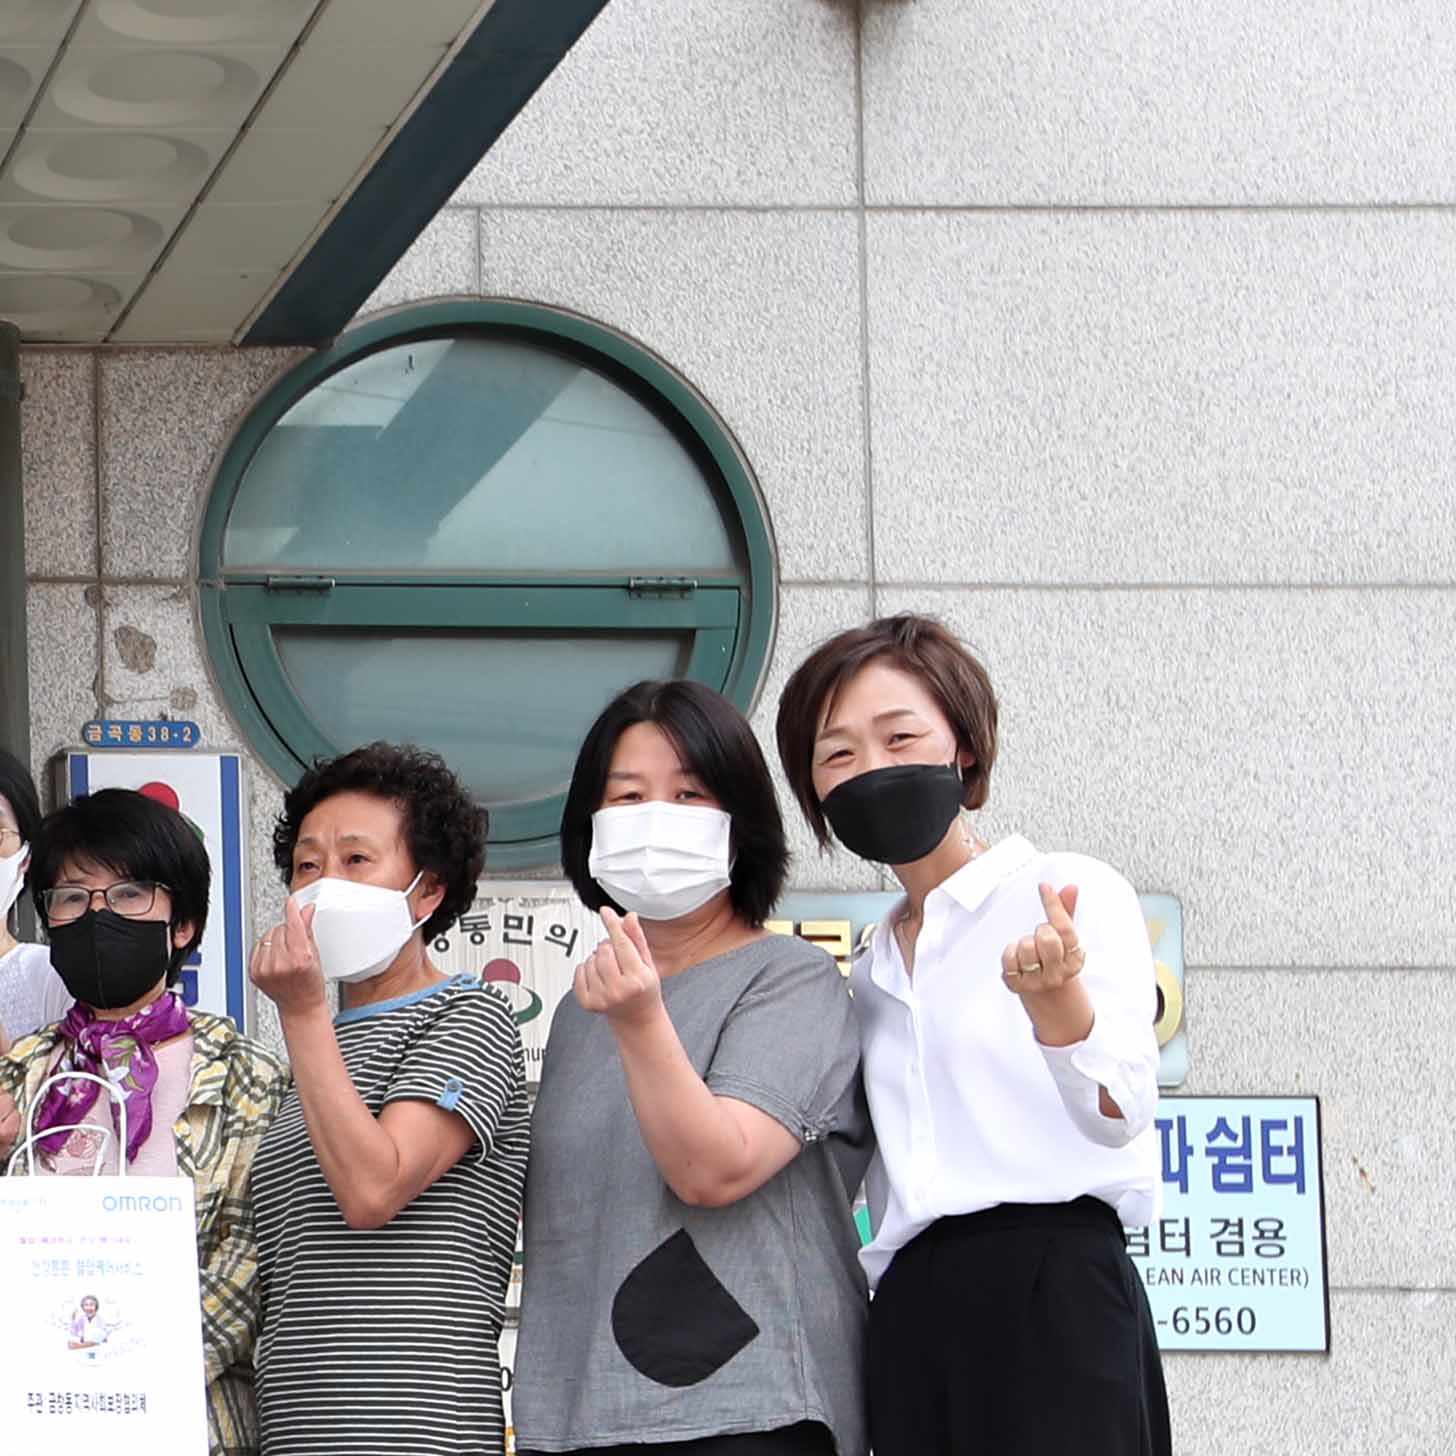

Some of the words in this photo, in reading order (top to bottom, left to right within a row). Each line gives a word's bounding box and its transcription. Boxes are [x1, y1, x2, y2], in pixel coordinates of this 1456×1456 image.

[1154, 1114, 1306, 1195] 파쉼터
[102, 1195, 182, 1212] OMRON
[1209, 1217, 1288, 1259] 겸용
[1145, 1267, 1185, 1287] EAN
[1190, 1267, 1222, 1287] AIR
[1227, 1266, 1310, 1289] CENTER)
[1156, 1306, 1257, 1336] -6560
